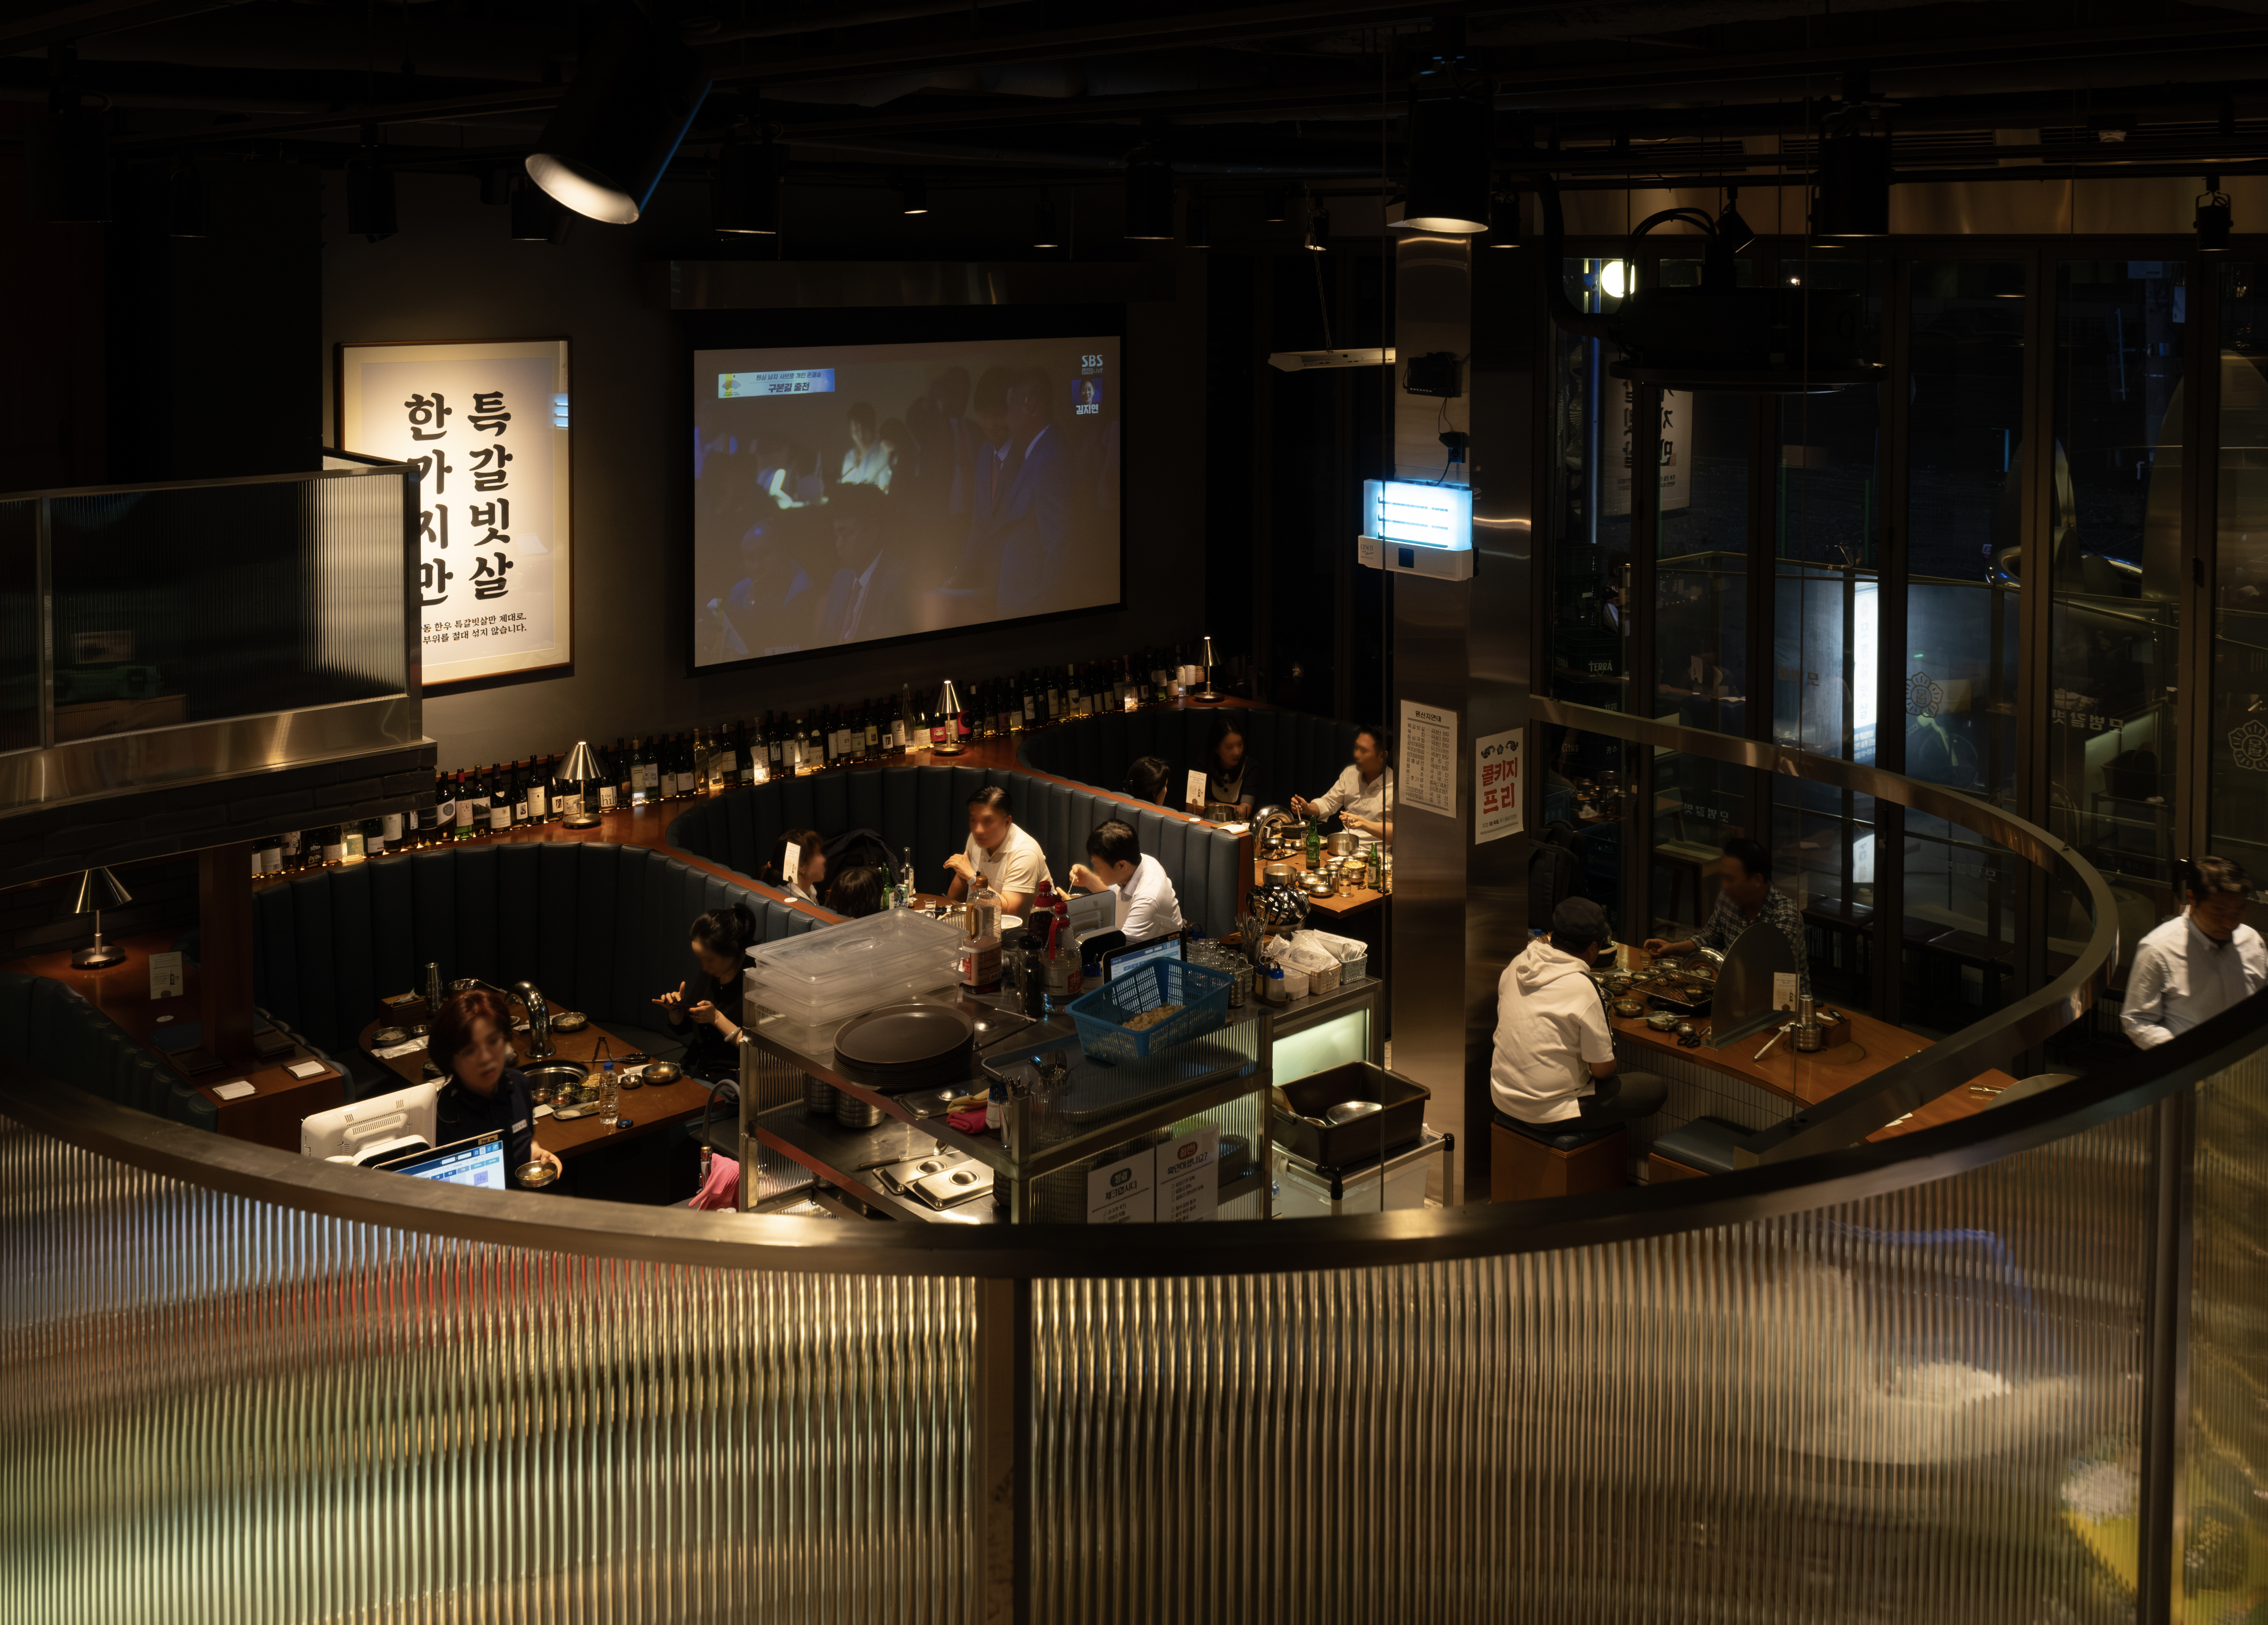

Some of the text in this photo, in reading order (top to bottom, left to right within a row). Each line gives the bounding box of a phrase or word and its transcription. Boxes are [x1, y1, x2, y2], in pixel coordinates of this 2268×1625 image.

[1082, 354, 1103, 367] SBS
[768, 382, 810, 393] 구본길 출전
[1076, 403, 1098, 415] 김지연
[468, 391, 514, 600] 특갈빗살
[435, 622, 452, 631] 한우
[455, 615, 496, 628] 특갈빗살만
[499, 613, 526, 622] 제대로.
[423, 624, 527, 644] 부위를 절대 섞지 않습니다.
[1589, 660, 1612, 672] TERRA
[1416, 711, 1441, 722] 원산지안내
[1606, 744, 1618, 754] 카스
[1482, 756, 1518, 787] 콜키지
[1483, 782, 1515, 815] 프리
